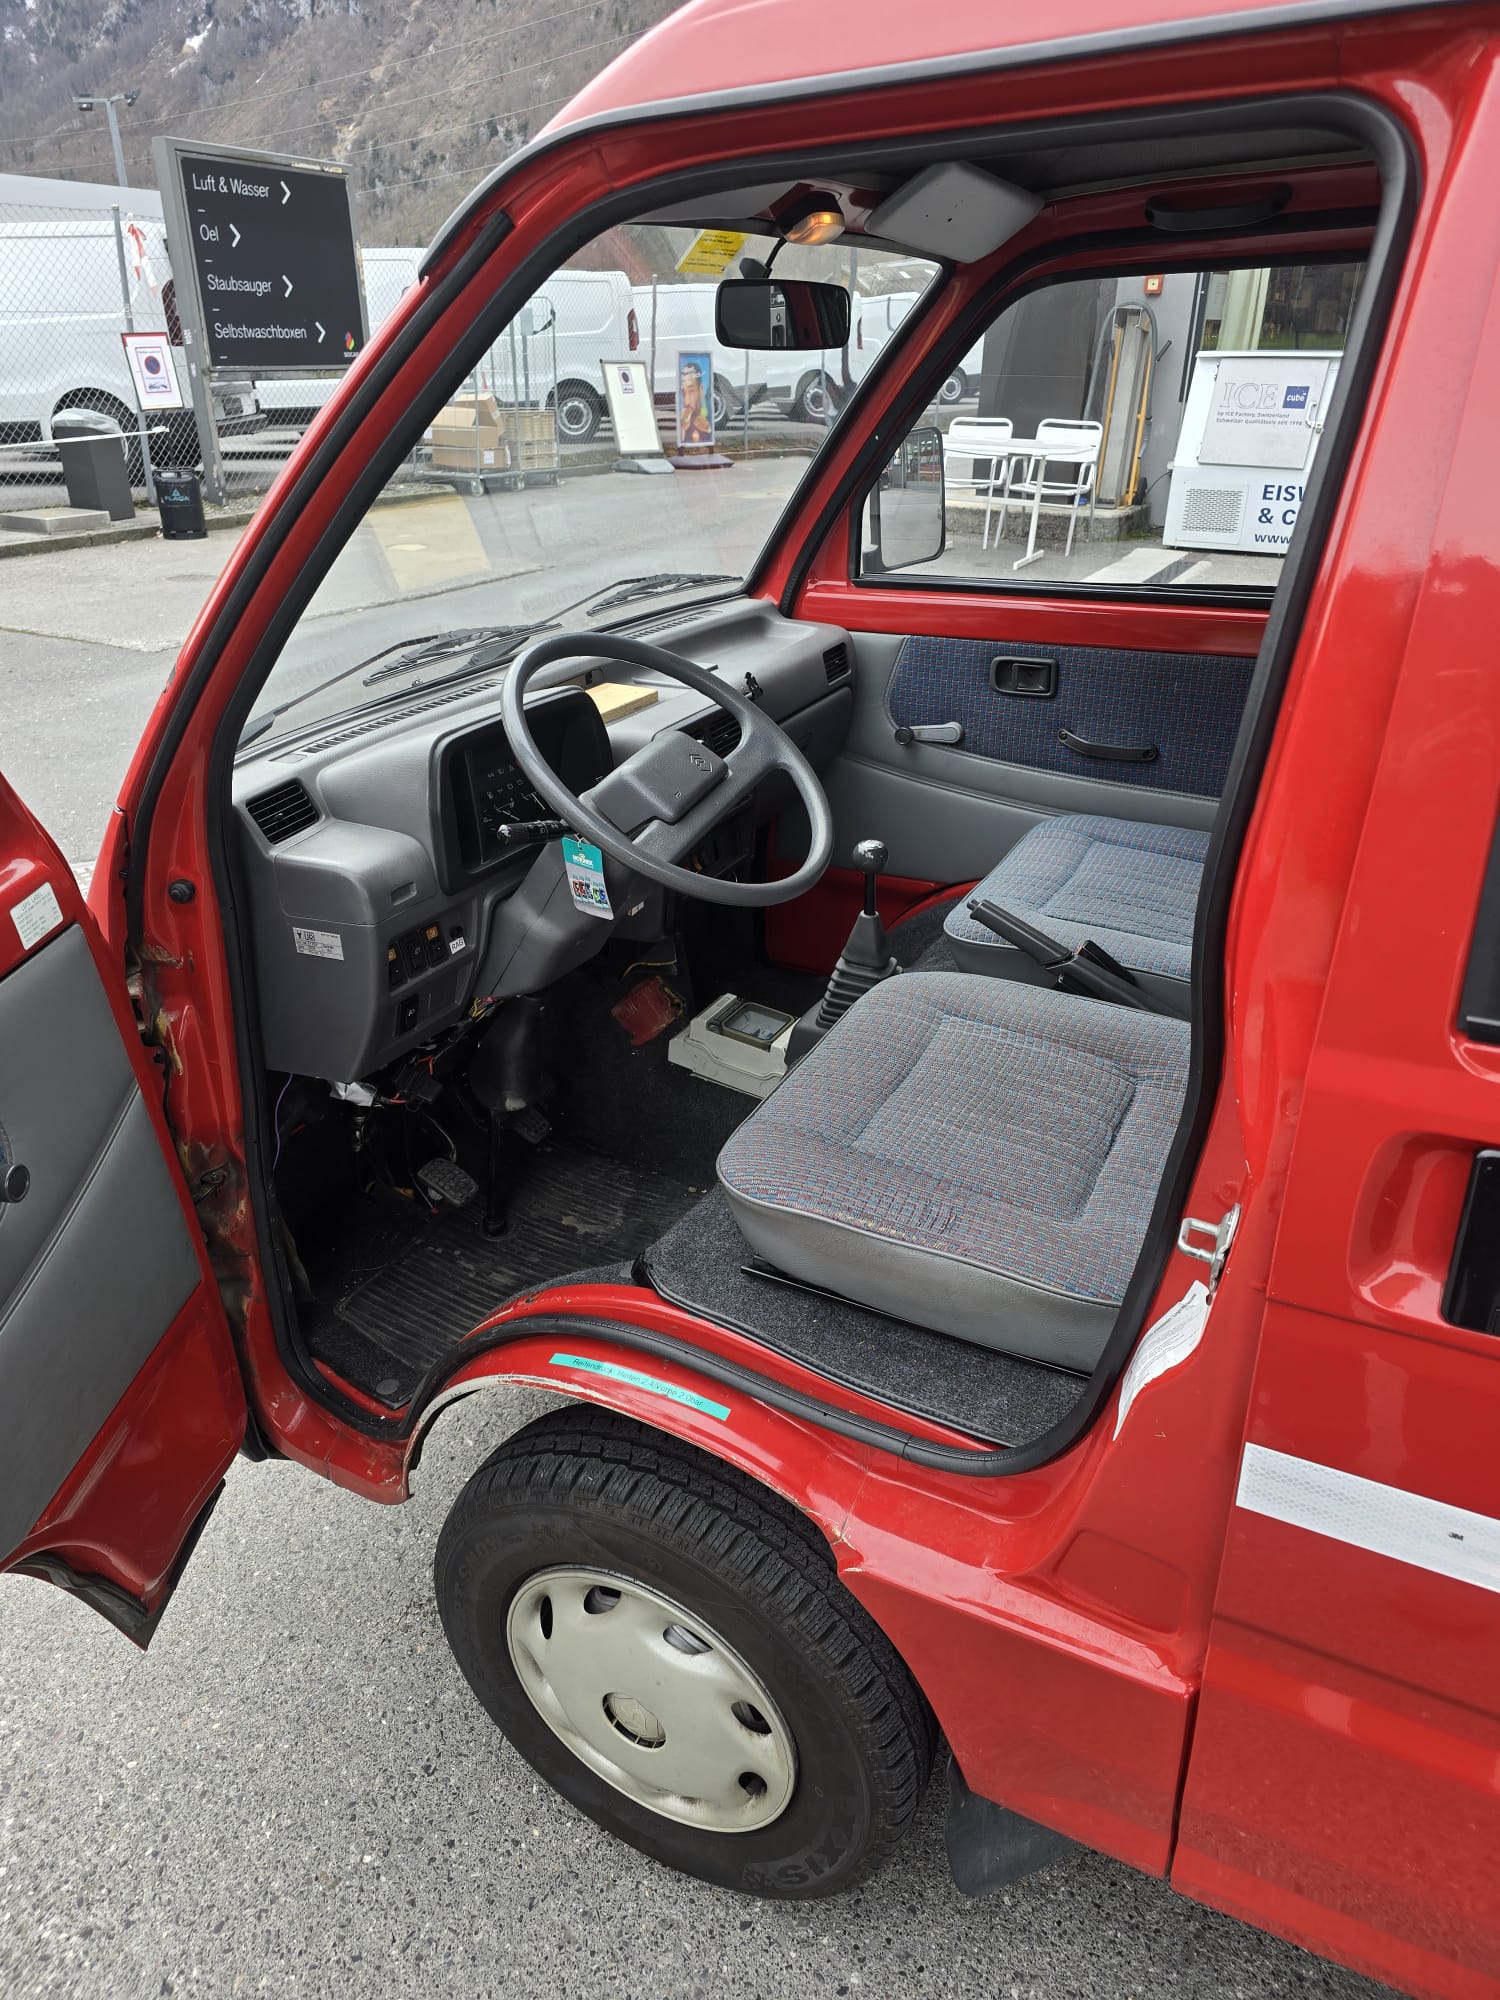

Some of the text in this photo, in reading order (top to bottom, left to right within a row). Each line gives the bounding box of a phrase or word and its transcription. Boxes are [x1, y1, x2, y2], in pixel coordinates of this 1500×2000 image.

[192, 173, 270, 198] Luft & Wasser
[199, 224, 220, 242] Oel
[207, 273, 272, 296] Staubsauger
[213, 322, 307, 340] Selbstwaschboxen
[1219, 382, 1305, 409] ICE cube
[1262, 484, 1304, 502] EIS
[1258, 508, 1274, 525] &
[1447, 1532, 1465, 1542] 3M
